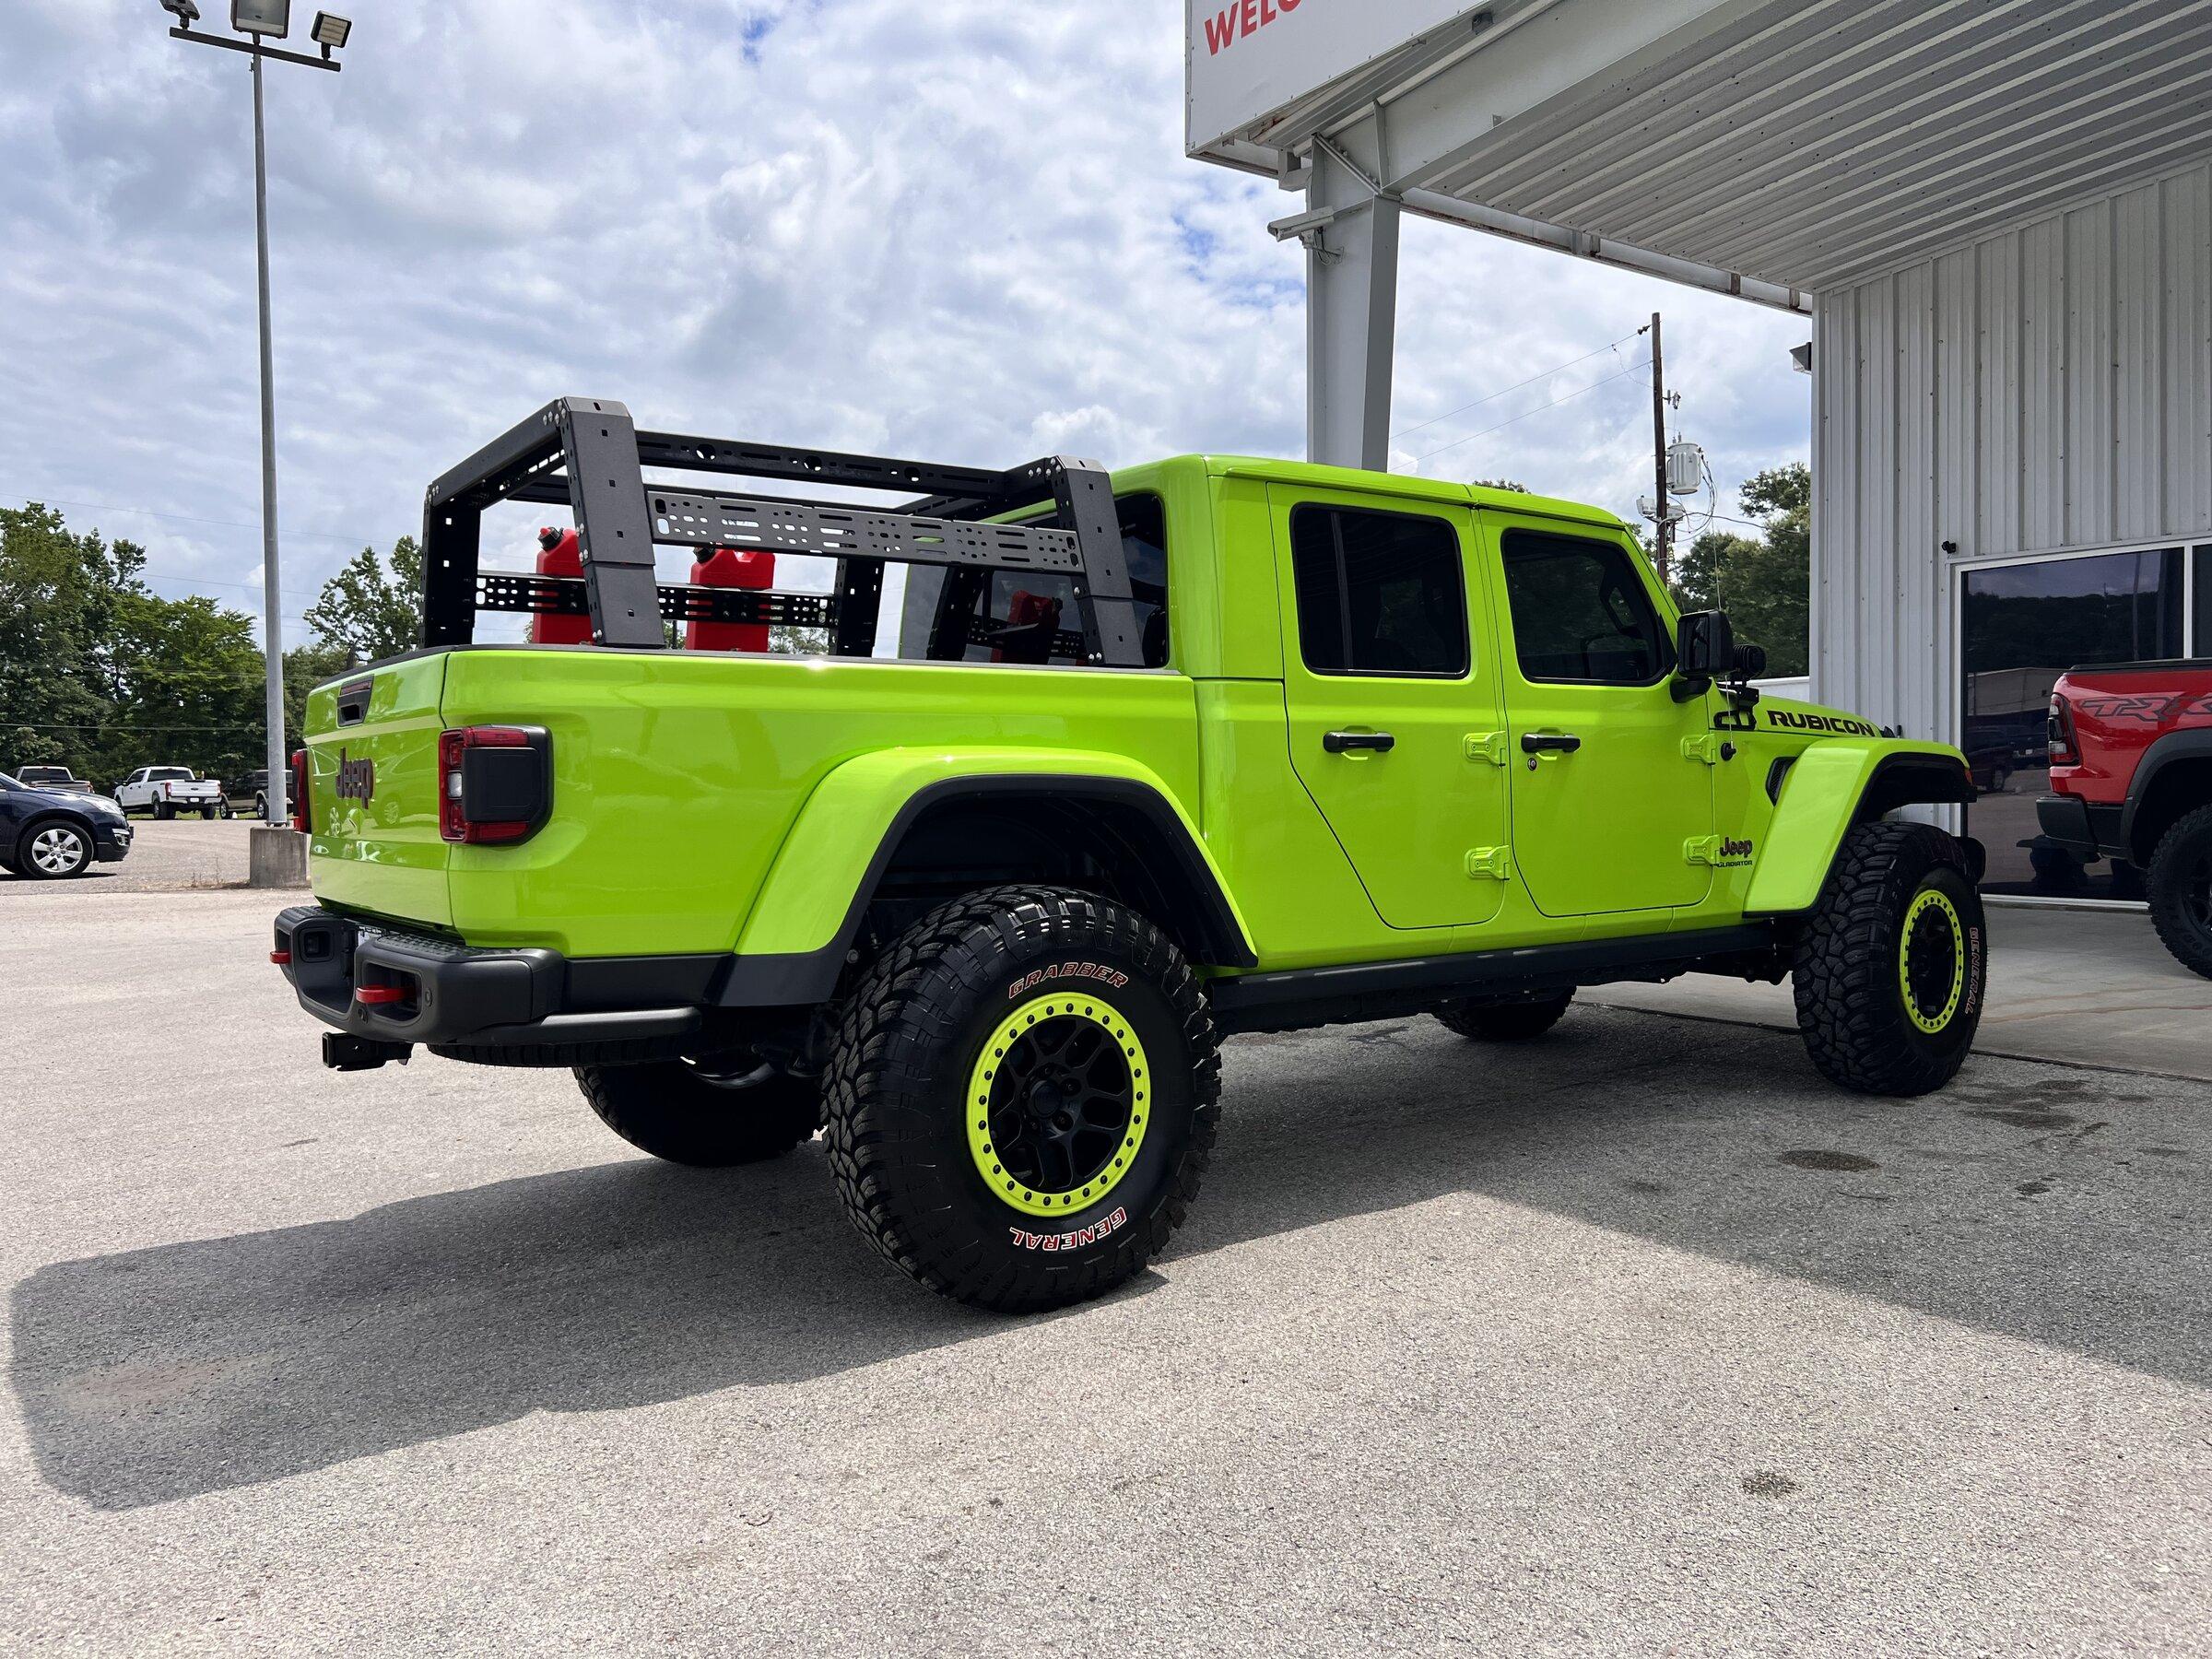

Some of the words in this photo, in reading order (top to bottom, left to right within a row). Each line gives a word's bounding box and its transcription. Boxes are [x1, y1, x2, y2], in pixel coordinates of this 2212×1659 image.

[1767, 710, 1876, 737] RUBICON
[335, 747, 374, 810] Jeep
[1718, 860, 1753, 868] GLADIATOR
[1720, 836, 1753, 858] Jeep
[1008, 961, 1129, 1000] GRABBER
[1964, 926, 1981, 1015] GENERAL
[1009, 1206, 1128, 1252] GENERAL
